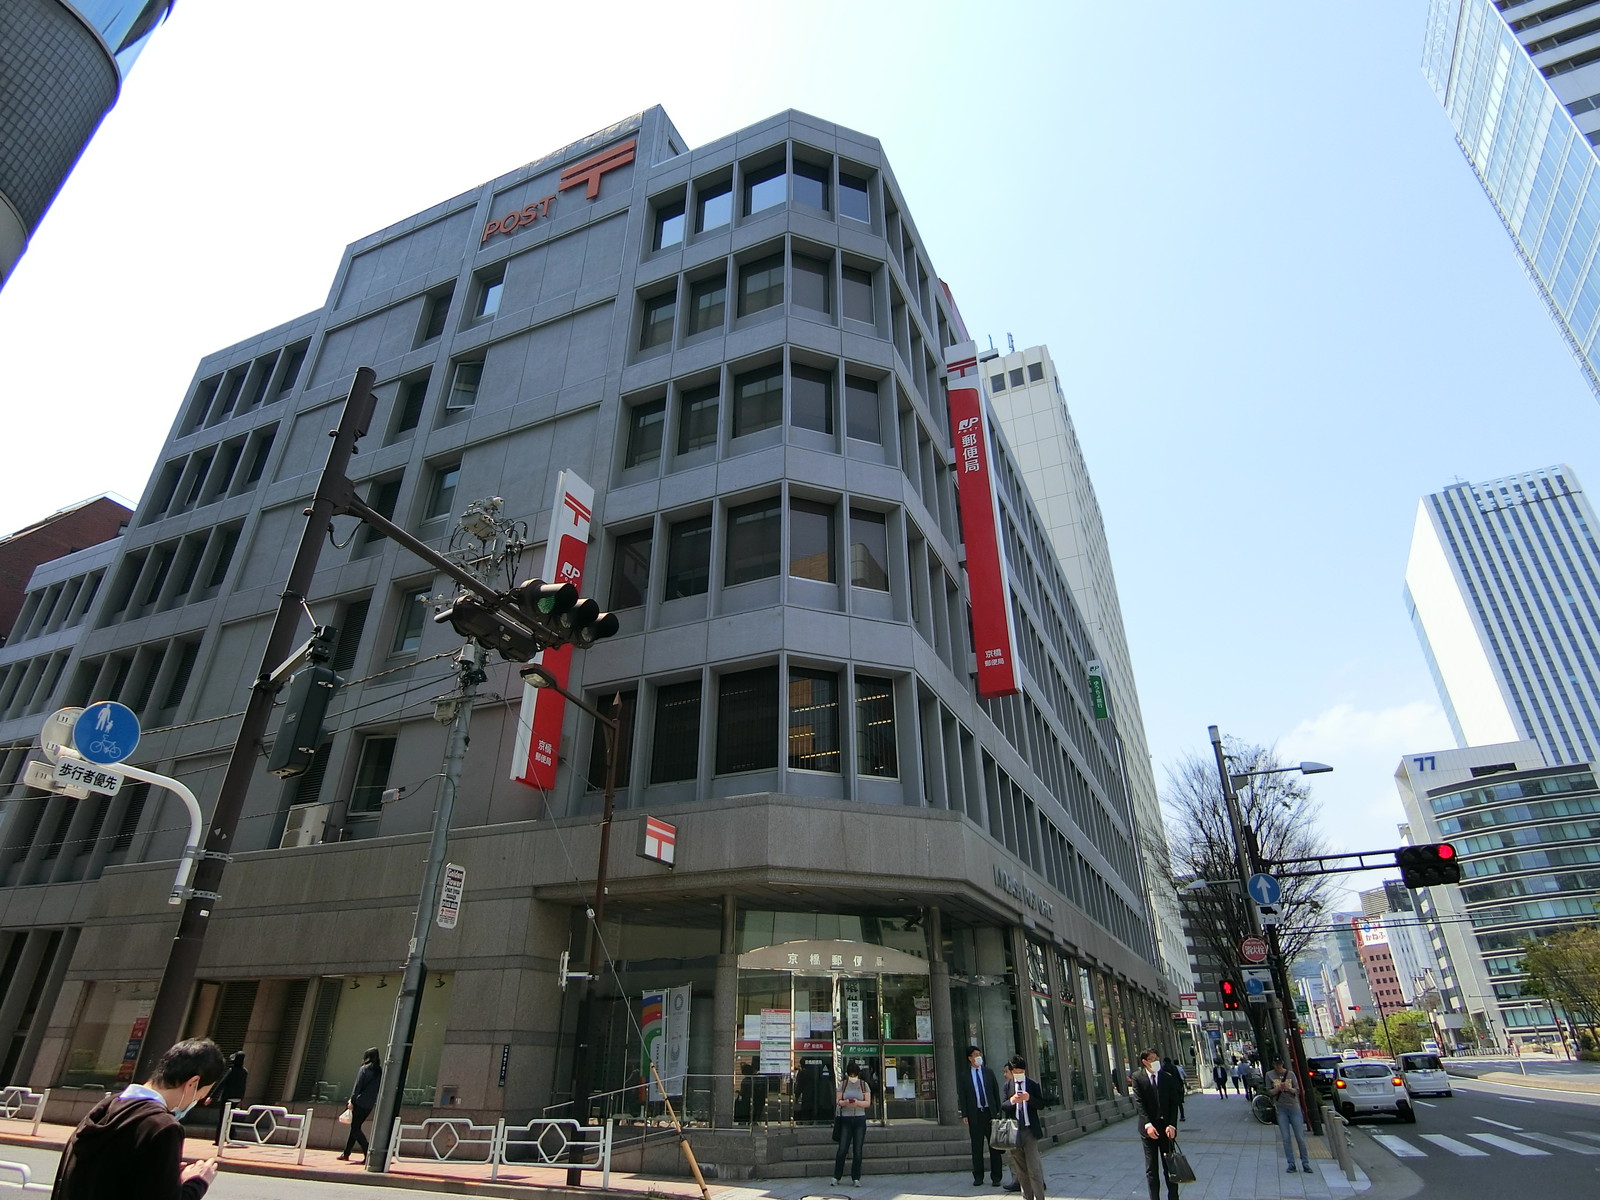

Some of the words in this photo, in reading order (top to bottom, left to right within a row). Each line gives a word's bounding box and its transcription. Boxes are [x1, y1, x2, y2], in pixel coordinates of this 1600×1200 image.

[482, 194, 556, 242] POST
[962, 433, 980, 474] 郵便局
[58, 763, 118, 791] 歩行者優先
[1413, 755, 1435, 771] 77
[787, 953, 885, 967] 京橋郵便局
